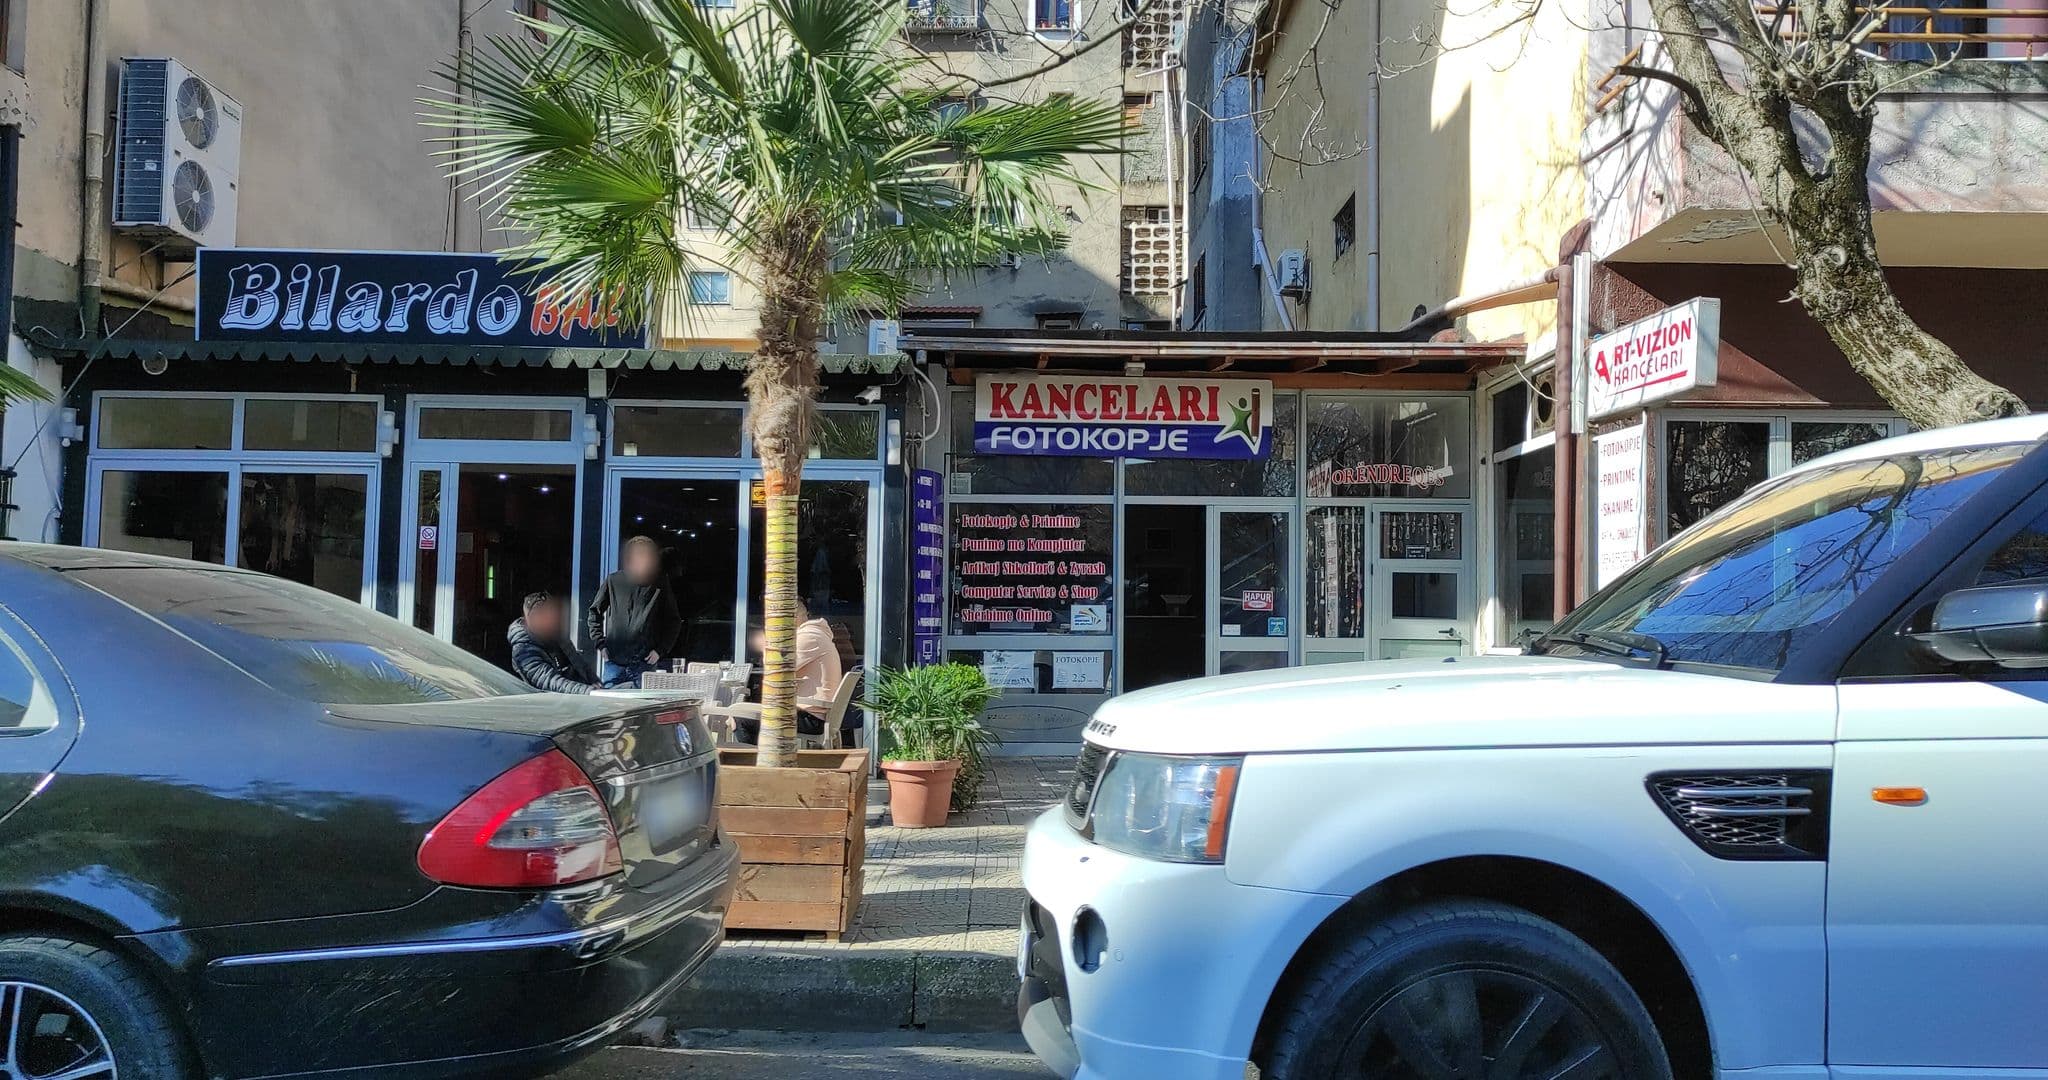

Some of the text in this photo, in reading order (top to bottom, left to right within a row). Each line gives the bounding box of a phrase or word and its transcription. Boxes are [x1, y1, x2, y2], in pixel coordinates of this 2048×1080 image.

[219, 263, 521, 336] Bilardo
[1614, 347, 1683, 388] KANCELARI
[989, 383, 1221, 422] KANCELARI
[990, 426, 1189, 452] FOTOKOPJE
[962, 514, 1080, 529] Fotokopje & Printime
[962, 538, 1086, 553] Punime me Kompjuter
[962, 561, 1000, 577] Artikuj
[1057, 561, 1068, 575] &
[1069, 561, 1106, 577] Zyrash
[962, 585, 1099, 600] Computer Service & Shop
[1244, 592, 1272, 603] HAPUR
[1016, 609, 1053, 622] Online
